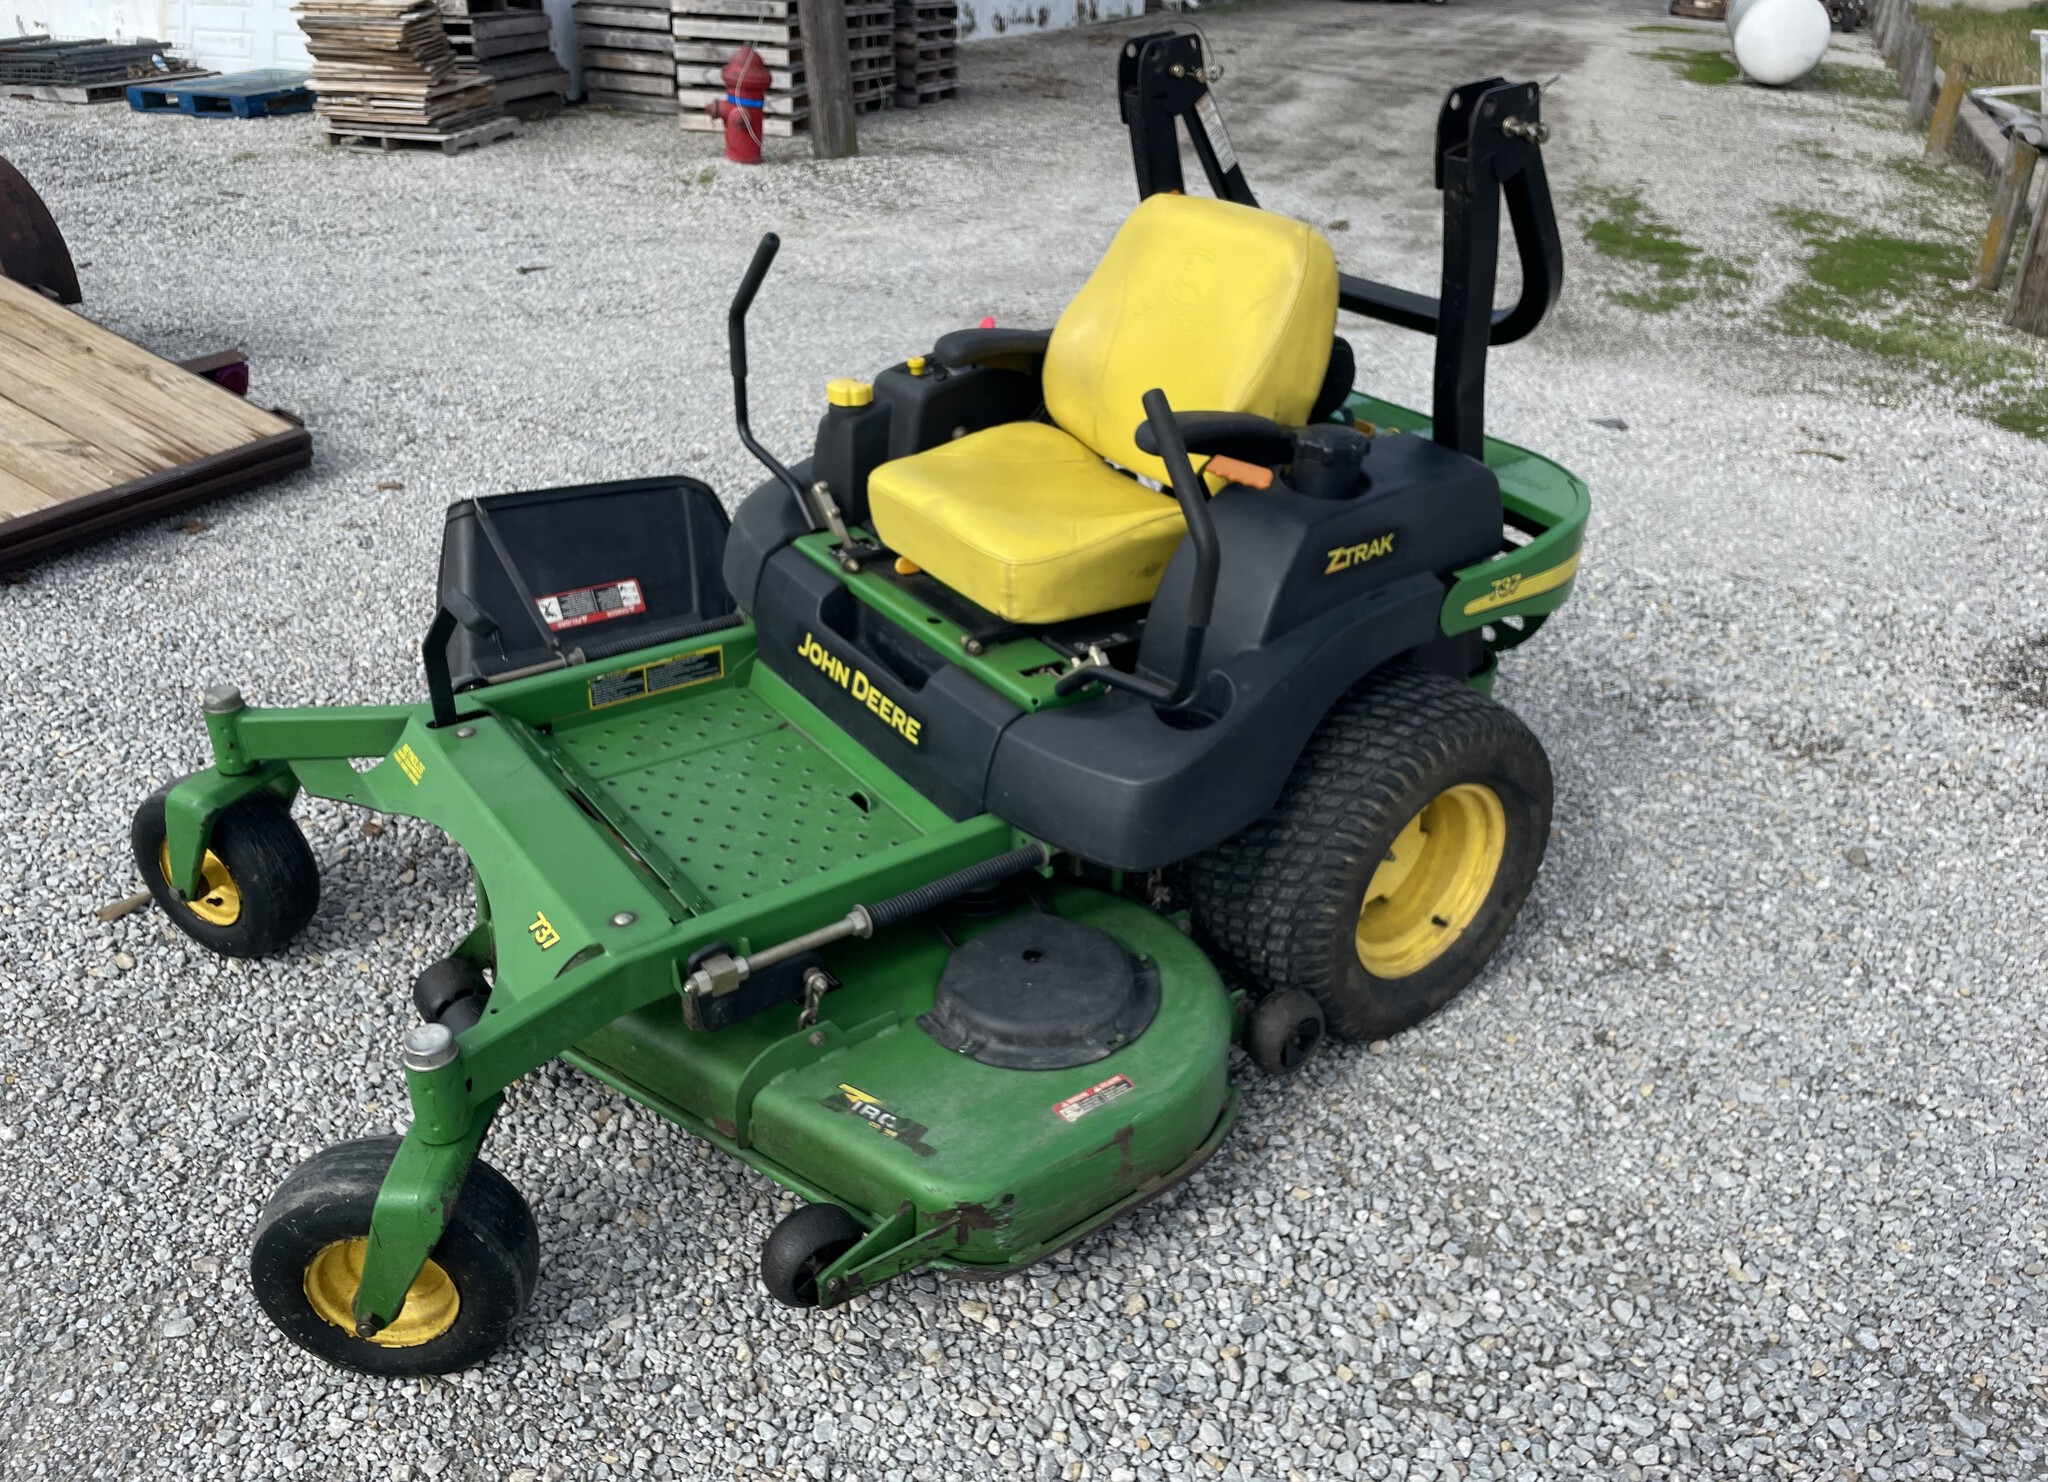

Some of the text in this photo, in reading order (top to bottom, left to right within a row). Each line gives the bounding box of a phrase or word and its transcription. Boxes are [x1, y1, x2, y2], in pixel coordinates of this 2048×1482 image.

[1324, 532, 1395, 575] ZTRAK
[797, 632, 851, 689] JOHN
[851, 669, 922, 745] DEERE
[528, 910, 561, 950] 737
